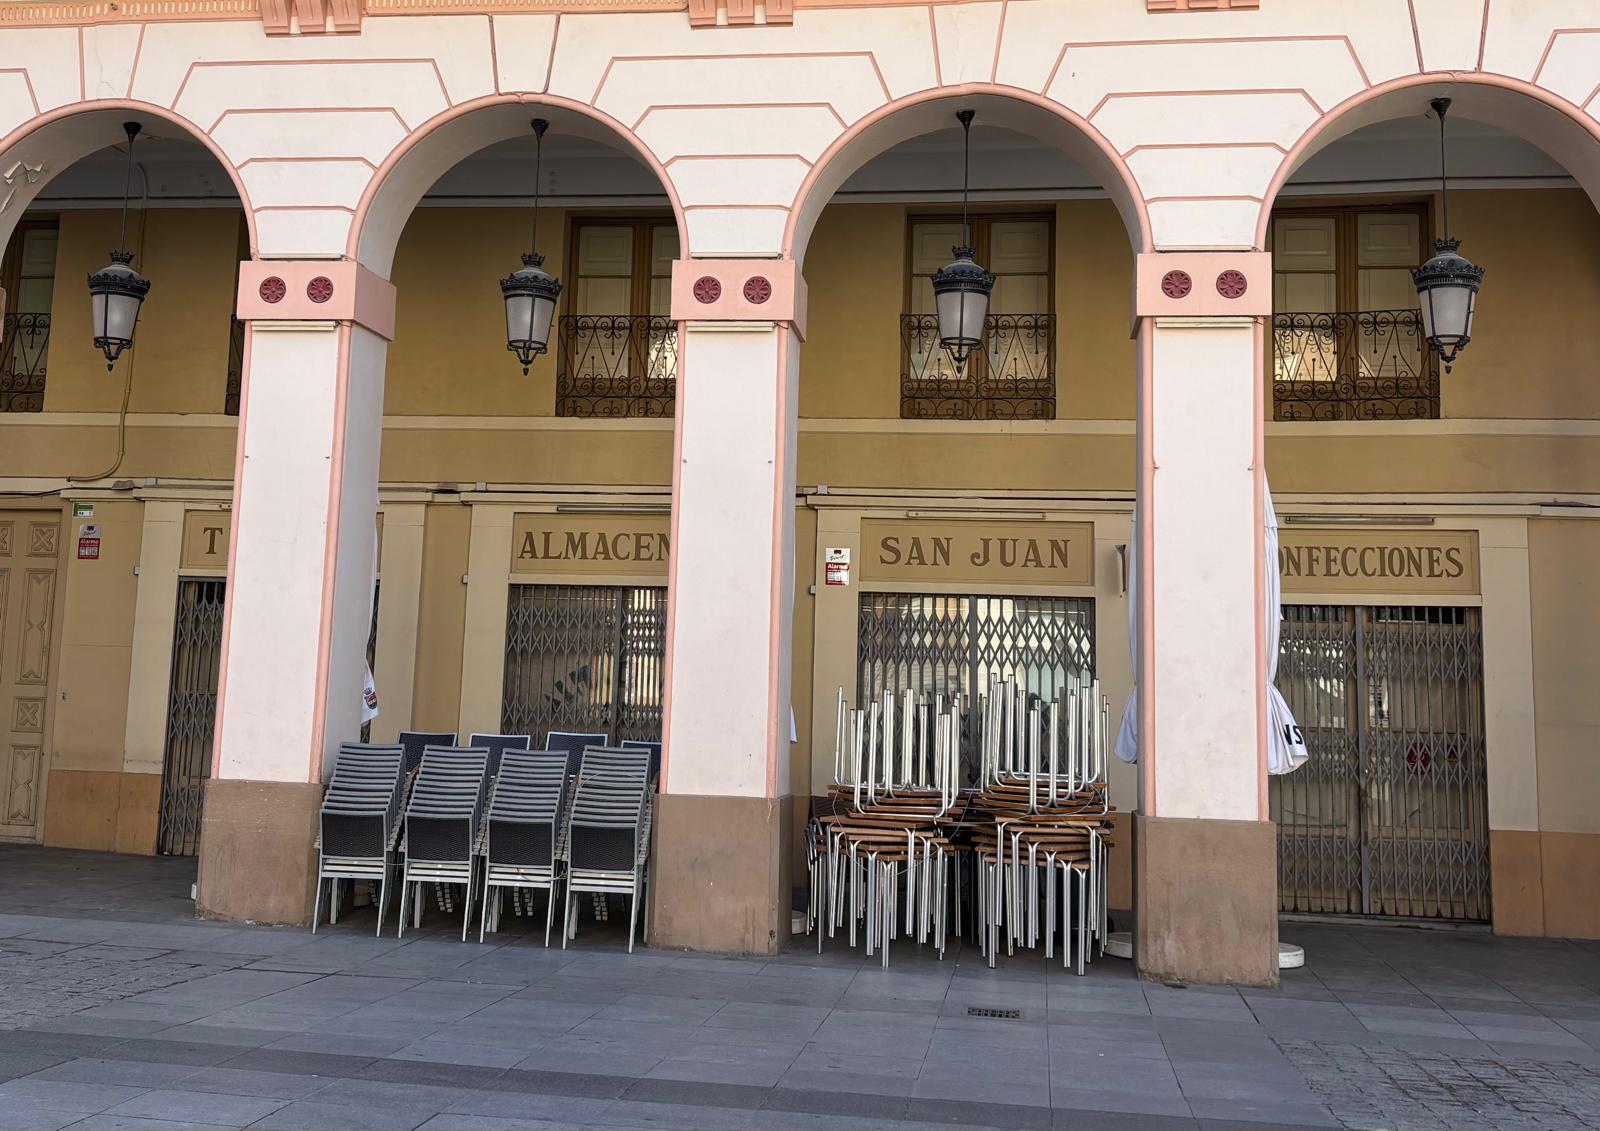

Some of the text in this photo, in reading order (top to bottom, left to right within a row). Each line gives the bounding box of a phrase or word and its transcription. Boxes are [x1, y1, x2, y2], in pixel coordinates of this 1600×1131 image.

[203, 527, 229, 554] T
[879, 536, 1071, 568] SAN JUAN
